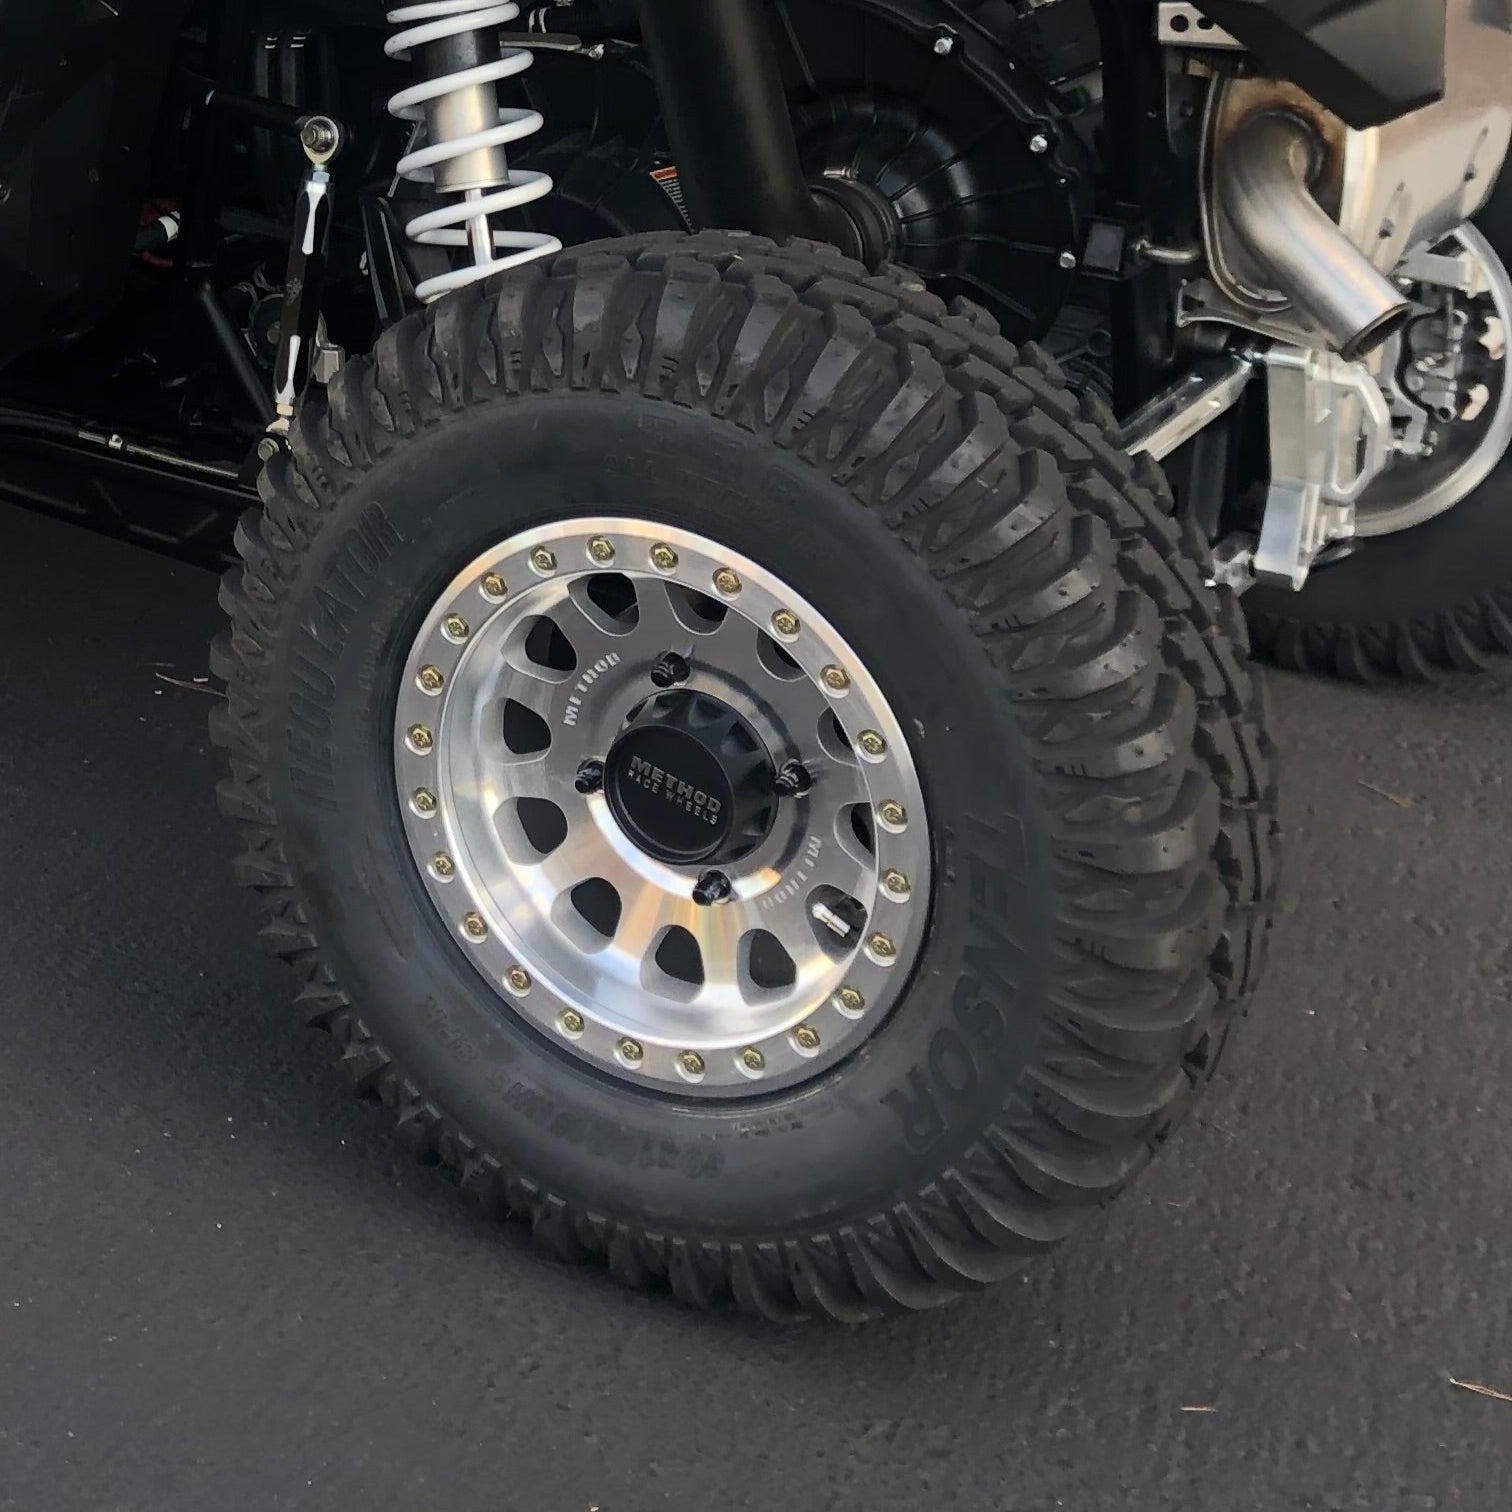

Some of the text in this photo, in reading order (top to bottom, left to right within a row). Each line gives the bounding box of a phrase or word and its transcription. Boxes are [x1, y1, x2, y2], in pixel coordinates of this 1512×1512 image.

[627, 769, 719, 825] RACE WHEELS
[629, 755, 722, 814] METHOD
